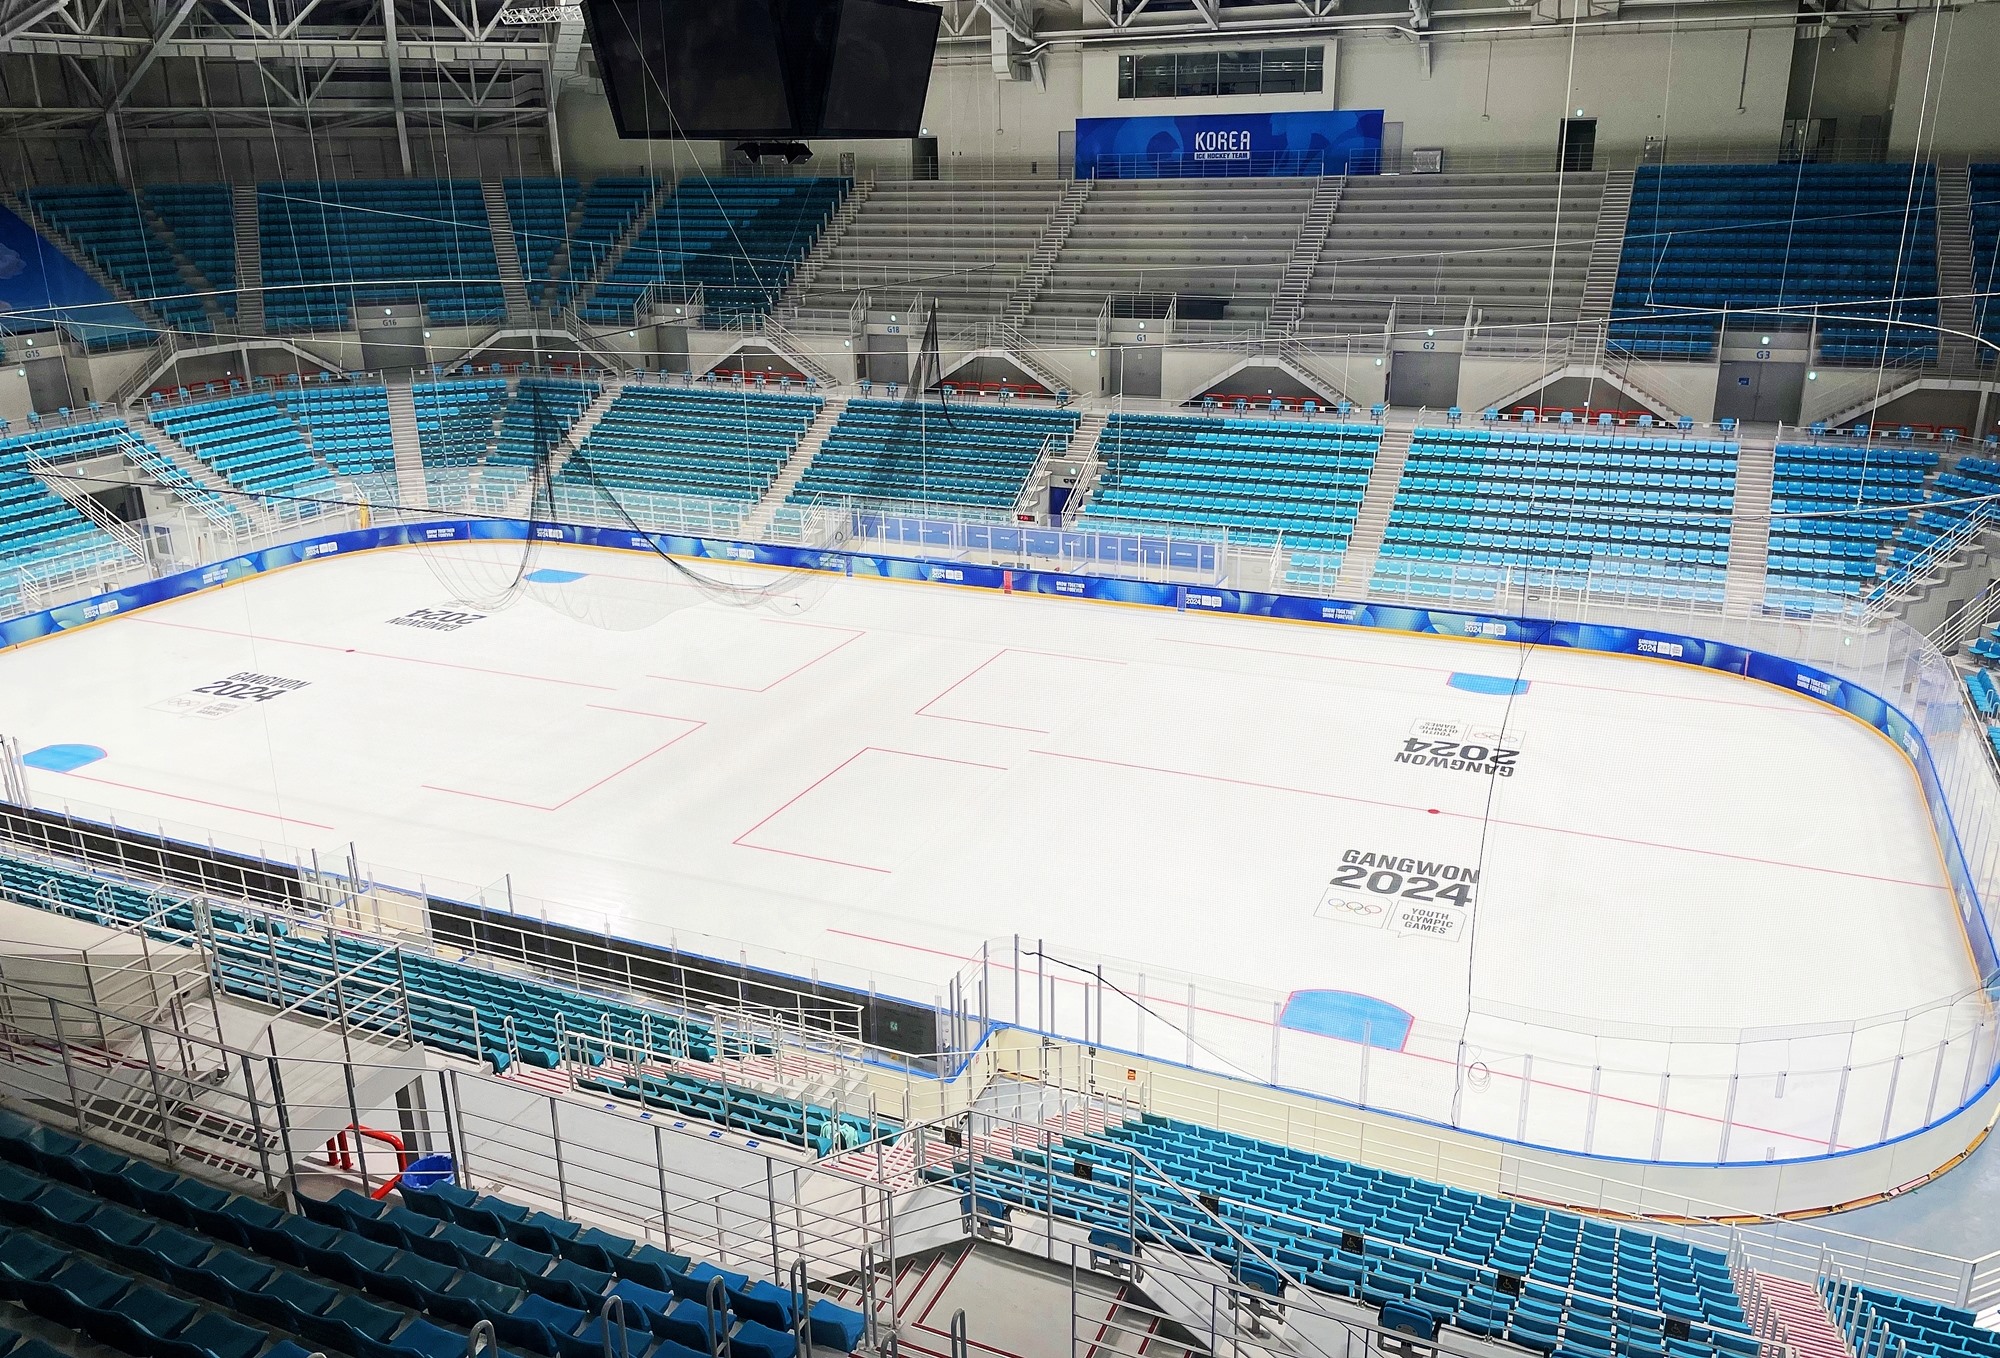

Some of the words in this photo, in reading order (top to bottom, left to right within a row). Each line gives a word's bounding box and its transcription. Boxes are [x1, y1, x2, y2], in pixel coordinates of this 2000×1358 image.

[1195, 130, 1251, 151] KOREA
[1196, 152, 1206, 160] ICE
[1207, 152, 1231, 160] HOCKEY
[1231, 152, 1249, 160] TEAM
[382, 319, 397, 327] G16
[886, 325, 900, 334] G18
[1136, 333, 1147, 342] G1
[1423, 341, 1436, 350] G2
[25, 349, 41, 359] G15
[1756, 350, 1771, 360] G3
[1186, 598, 1201, 606] 2024
[405, 608, 487, 624] 2024
[384, 617, 462, 632] GANGWON
[1464, 625, 1482, 634] 2024
[1637, 643, 1657, 653] 2024
[226, 671, 312, 691] GANGWON
[192, 680, 287, 702] 2024
[1419, 725, 1458, 734] OLYMPIC
[1424, 721, 1456, 730] GAMES
[1422, 729, 1451, 737] YOUTH
[1403, 737, 1520, 765] 2024
[1394, 752, 1514, 777] GANGWON
[1341, 849, 1479, 884] GANGWON
[1329, 864, 1473, 907] 2024
[1411, 907, 1450, 920] YOUTH
[1402, 913, 1454, 929] OLYMPIC
[1404, 921, 1446, 935] GAMES
